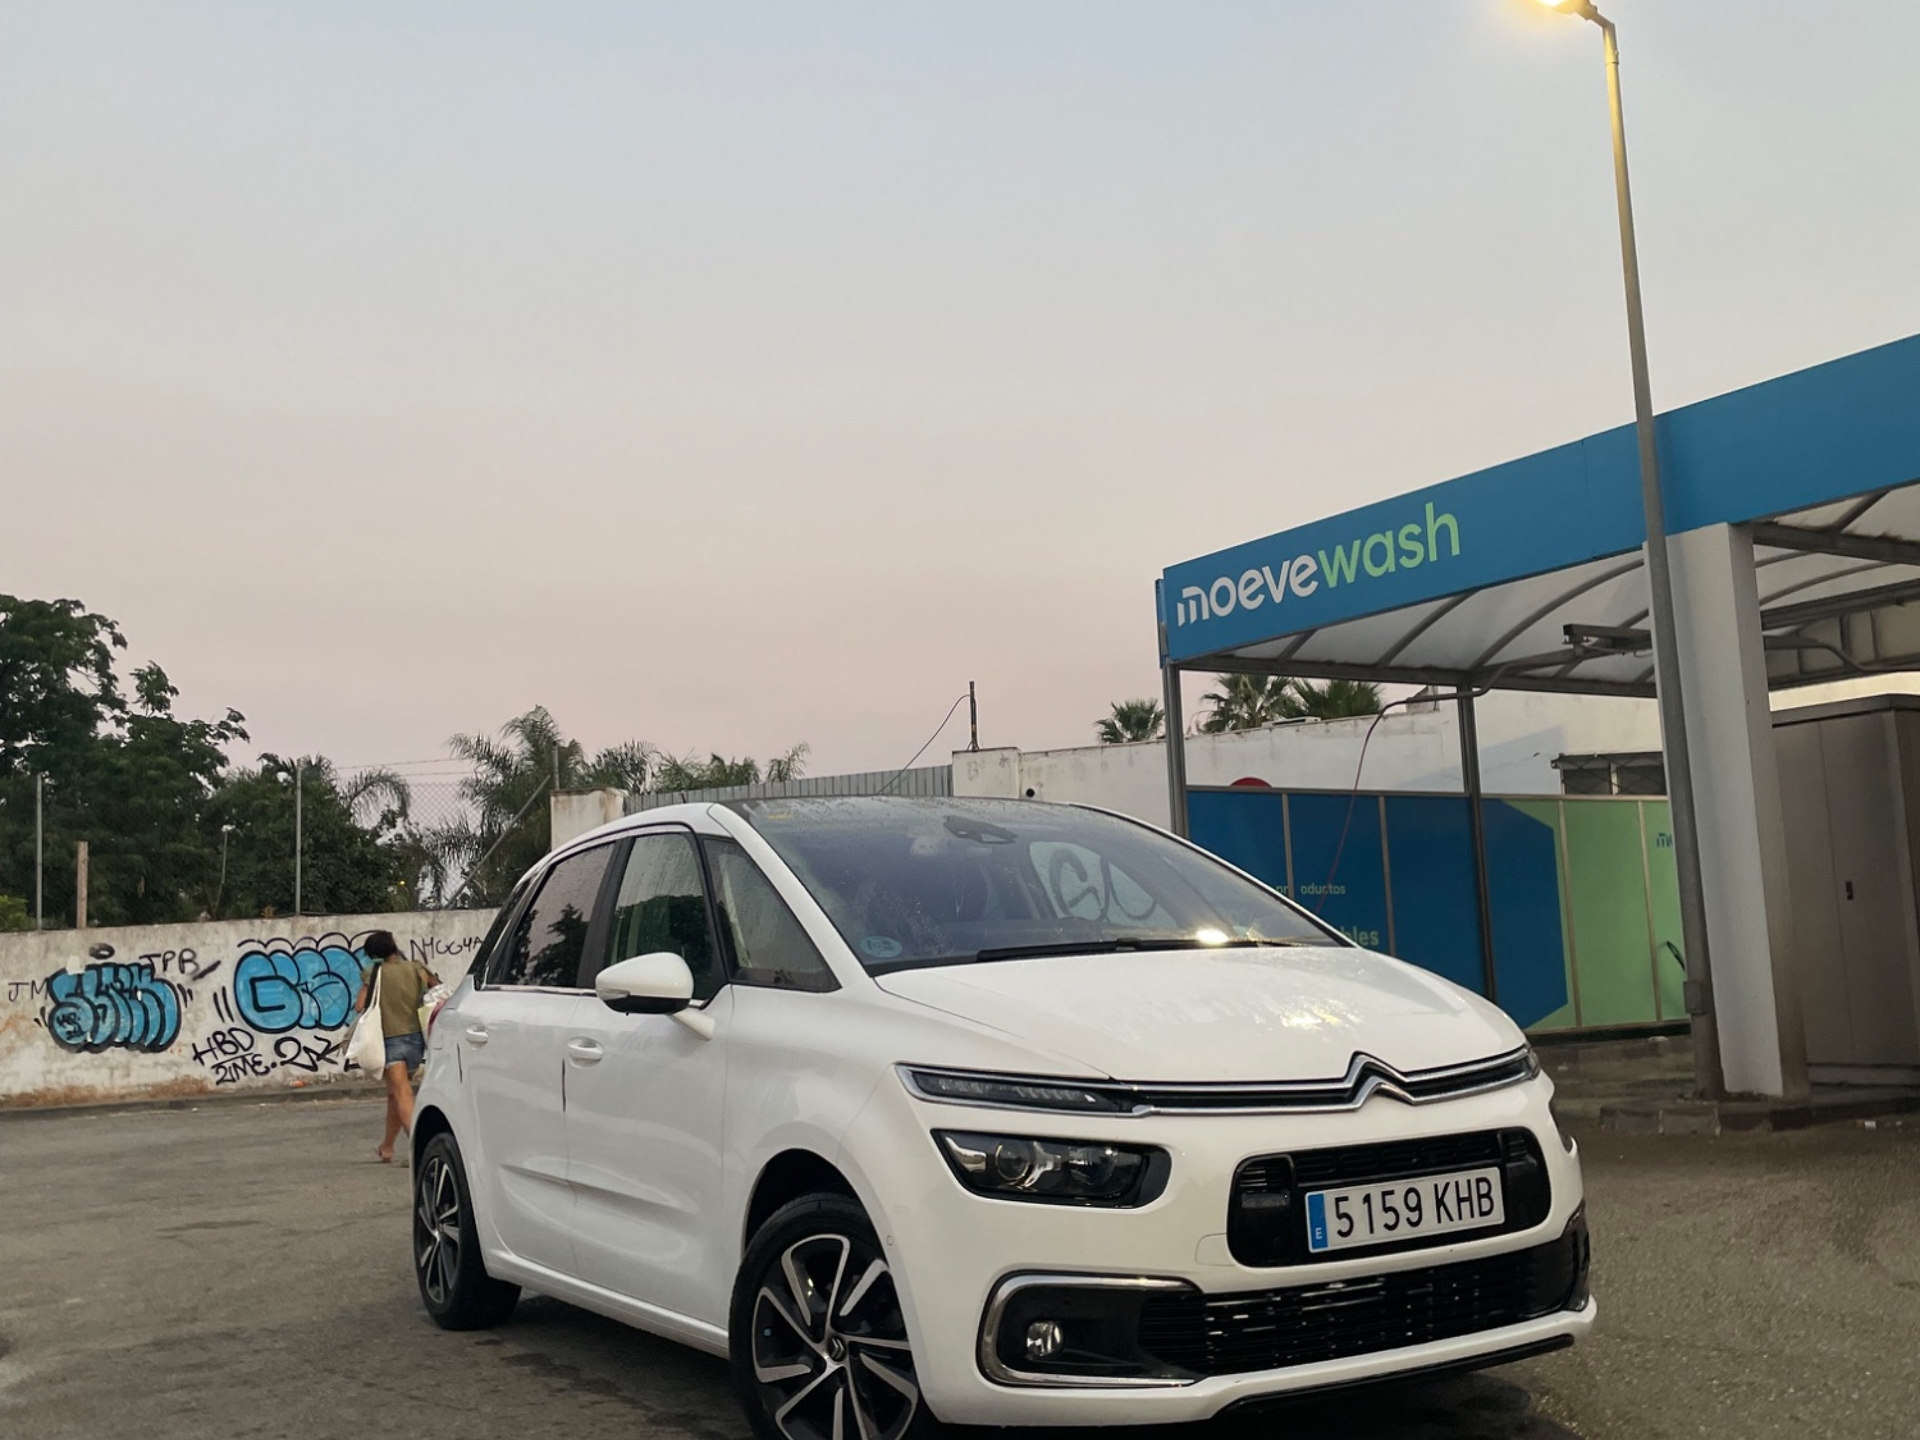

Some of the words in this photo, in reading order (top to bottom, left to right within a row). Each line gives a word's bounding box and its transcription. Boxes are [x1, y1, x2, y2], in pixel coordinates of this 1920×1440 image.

[192, 1027, 255, 1066] HBD
[1334, 1187, 1423, 1238] 5159
[1434, 1176, 1495, 1224] KHB
[1315, 1226, 1323, 1239] E
